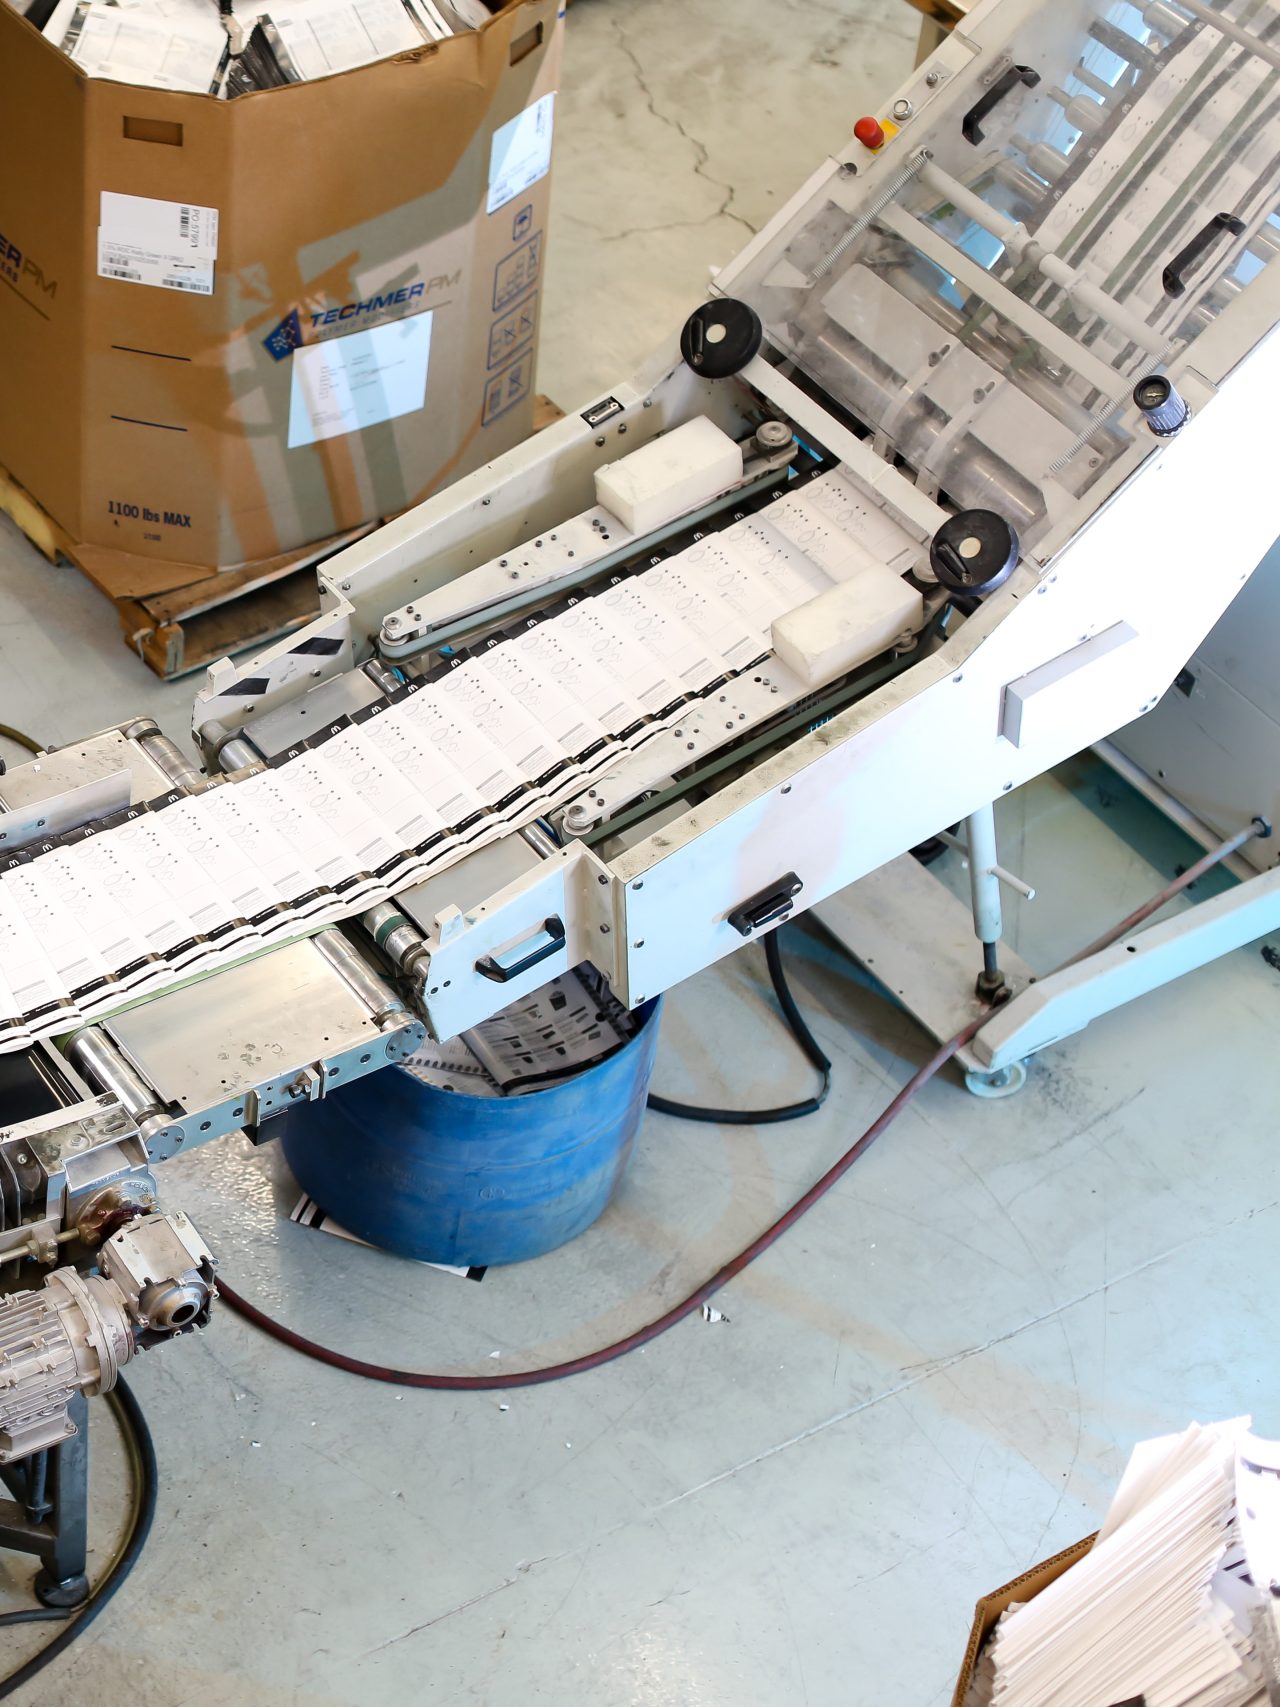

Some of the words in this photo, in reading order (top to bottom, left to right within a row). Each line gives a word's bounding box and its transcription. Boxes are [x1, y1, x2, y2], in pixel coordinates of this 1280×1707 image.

[108, 500, 139, 519] 1100
[143, 508, 160, 523] lbs
[163, 511, 192, 528] MAX
